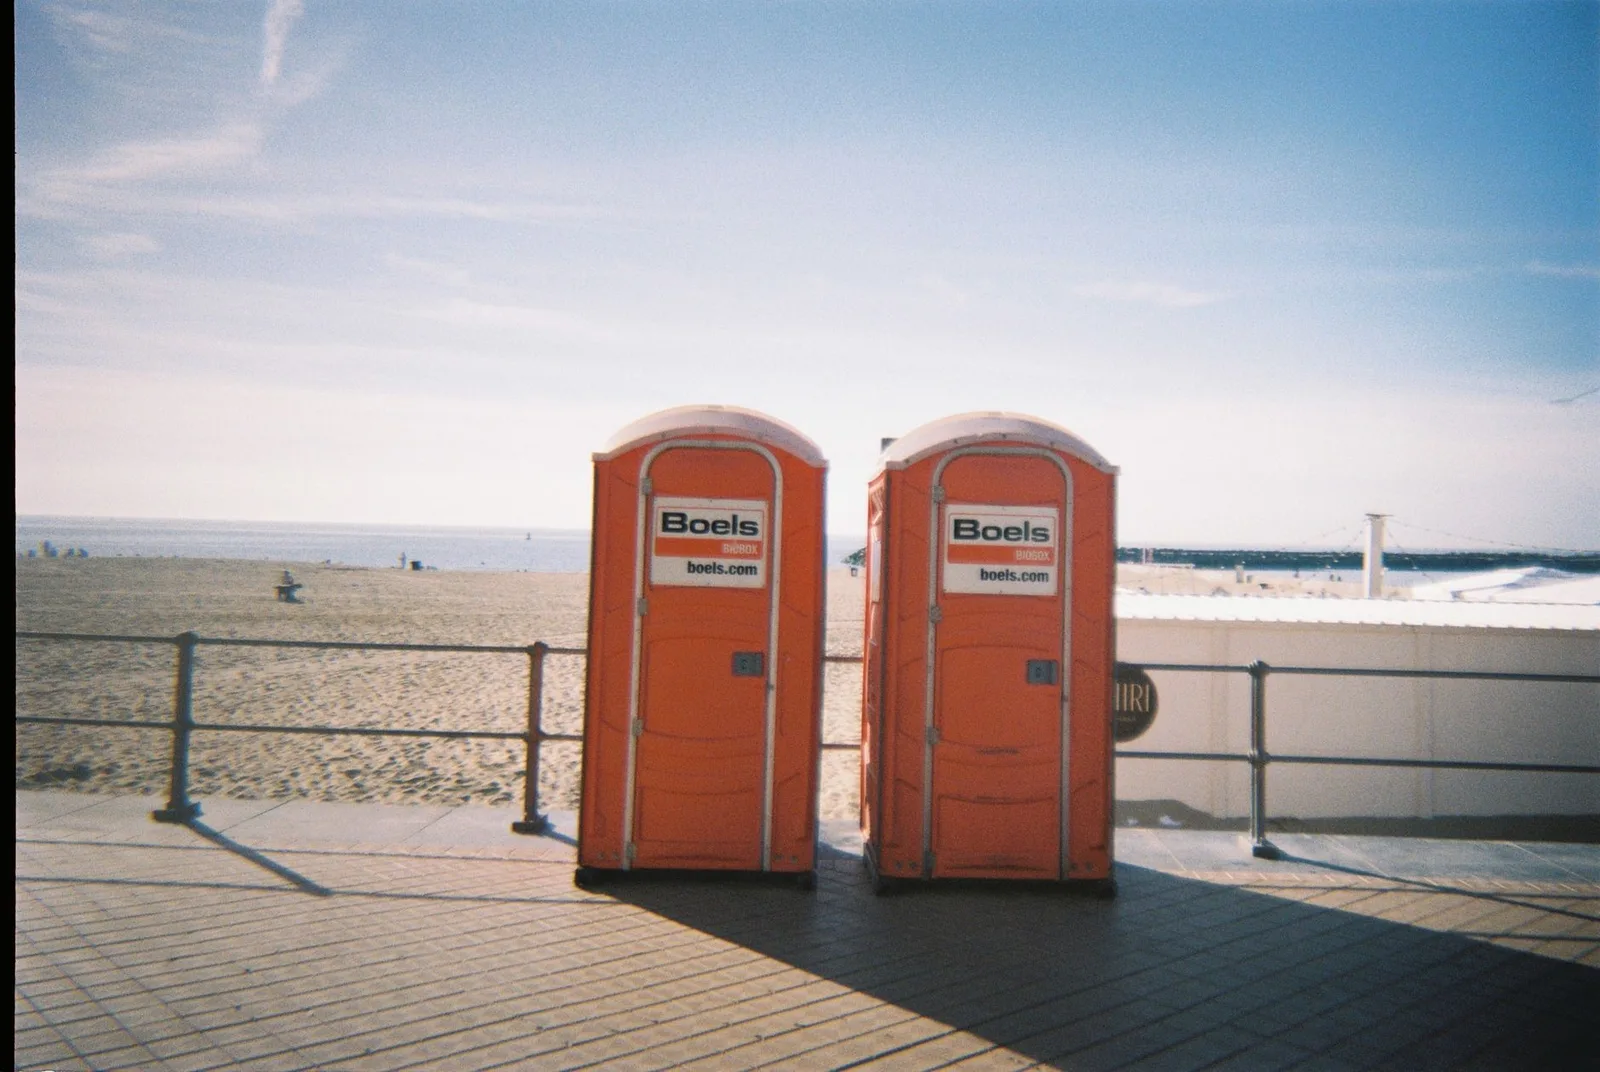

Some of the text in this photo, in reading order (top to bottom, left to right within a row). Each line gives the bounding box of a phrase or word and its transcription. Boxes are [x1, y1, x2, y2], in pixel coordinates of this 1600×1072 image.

[661, 512, 759, 536] Boels
[953, 519, 1050, 542] Boels
[1015, 550, 1051, 562] BIOBOX
[687, 561, 758, 576] boels.com
[980, 568, 1049, 583] boels.com
